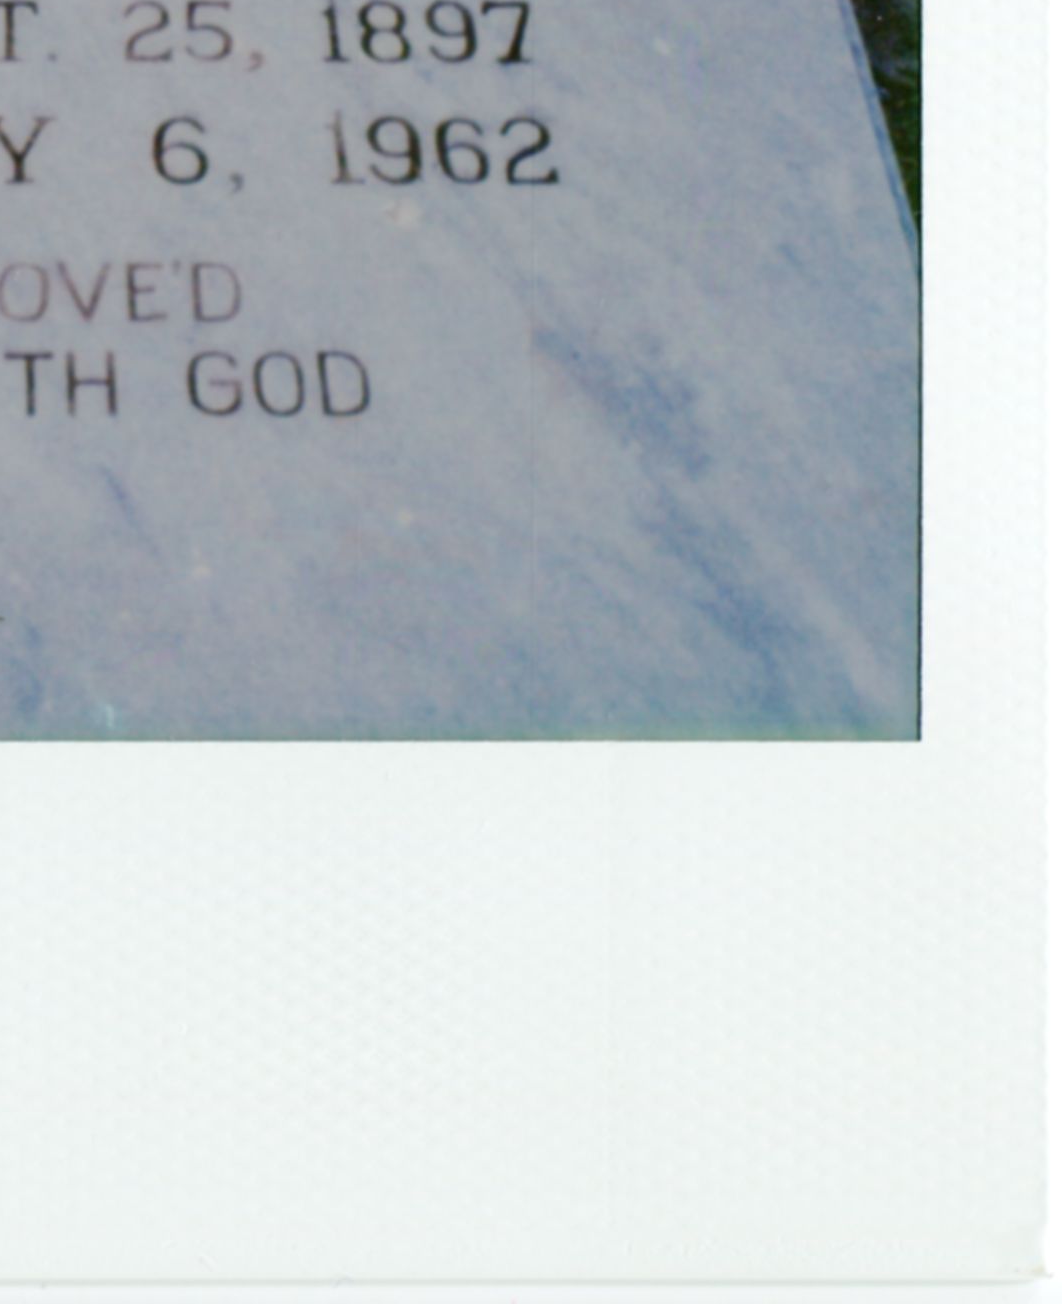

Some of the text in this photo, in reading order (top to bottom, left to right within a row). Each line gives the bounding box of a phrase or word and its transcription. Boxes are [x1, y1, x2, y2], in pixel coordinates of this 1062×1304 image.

[124, 0, 263, 70] 25,
[322, 0, 531, 63] 1897
[151, 116, 244, 192] 6,
[331, 115, 559, 184] 1962
[186, 351, 370, 417] GOD
